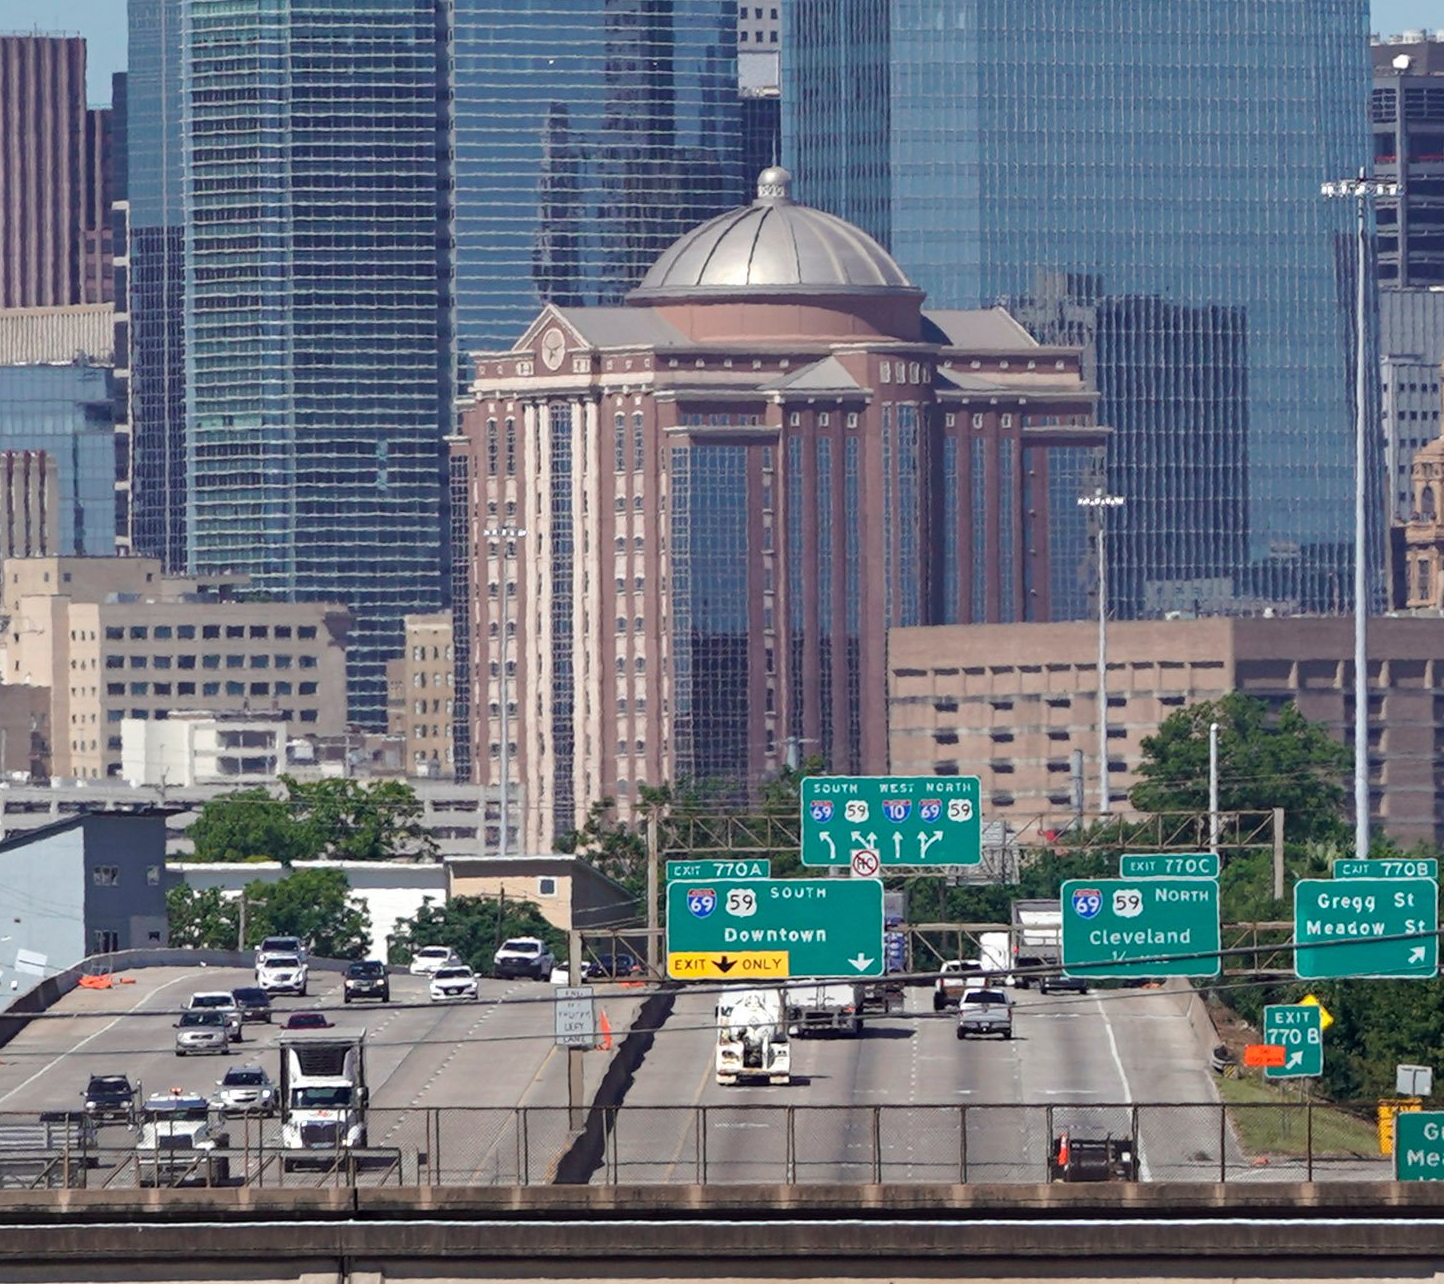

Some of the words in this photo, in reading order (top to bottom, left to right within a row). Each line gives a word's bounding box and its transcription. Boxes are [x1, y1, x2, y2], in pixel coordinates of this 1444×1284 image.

[813, 783, 858, 794] SOUTH
[879, 783, 915, 793] WEST
[926, 782, 972, 792] NORTH
[812, 807, 832, 819] 69
[847, 804, 867, 816] 59
[889, 807, 905, 819] 10
[921, 806, 940, 819] 69
[950, 803, 970, 817] 59
[673, 865, 701, 876] EXIT
[713, 862, 763, 876] 770A
[1130, 861, 1156, 872] EXIT
[1165, 858, 1210, 873] 770C
[1342, 864, 1369, 874] EXIT
[1381, 862, 1429, 876] 770B
[690, 895, 714, 911] 69
[729, 894, 753, 910] 59
[770, 886, 827, 899] SOUTH
[1076, 896, 1100, 914] 69
[1115, 895, 1141, 911] 59
[1155, 888, 1209, 902] NORTH
[1317, 893, 1376, 913] Gregg
[1393, 892, 1415, 908] St
[724, 927, 827, 942] Downtown
[1306, 920, 1385, 935] Meadow
[1404, 919, 1426, 934] St
[1089, 928, 1191, 945] Cleveland
[674, 959, 706, 971] EXIT
[742, 959, 782, 971] ONLY
[1275, 1011, 1310, 1024] EXIT
[1267, 1028, 1302, 1045] 770
[1307, 1027, 1320, 1044] B
